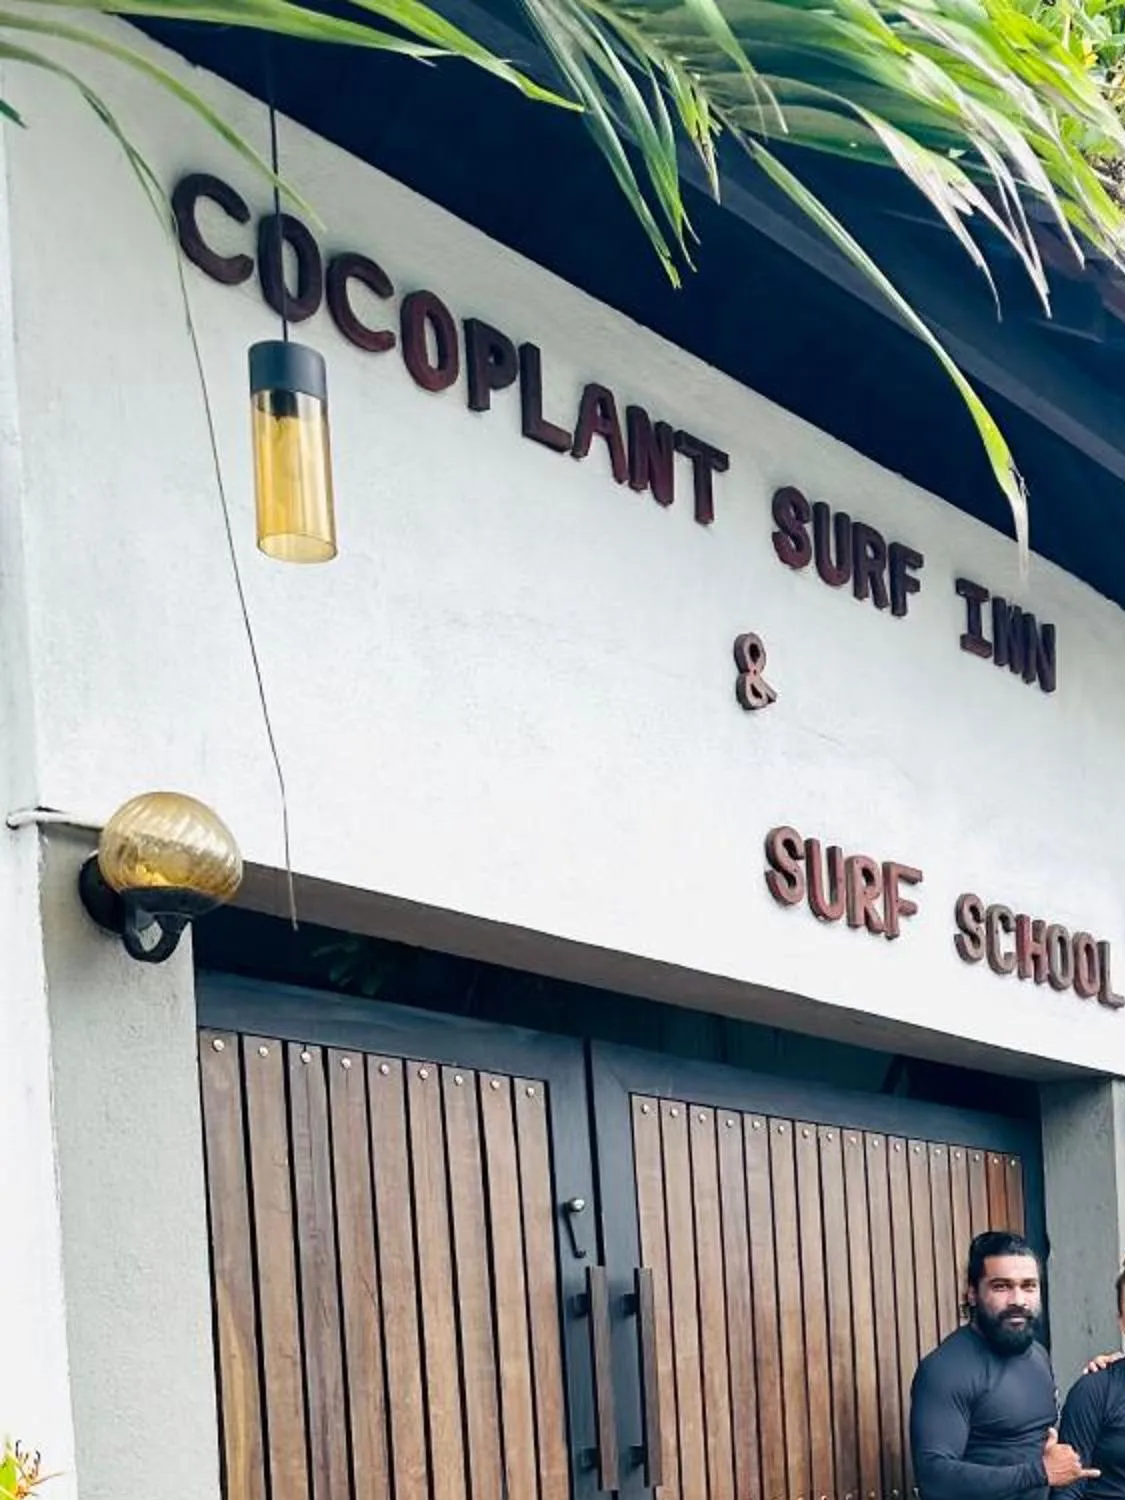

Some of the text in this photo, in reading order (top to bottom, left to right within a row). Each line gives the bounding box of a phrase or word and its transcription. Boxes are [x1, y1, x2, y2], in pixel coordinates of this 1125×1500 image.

[171, 172, 1057, 693] COCOPLANT SURF INN
[733, 632, 777, 711] &
[765, 825, 1125, 1010] SURF SCHOOL
